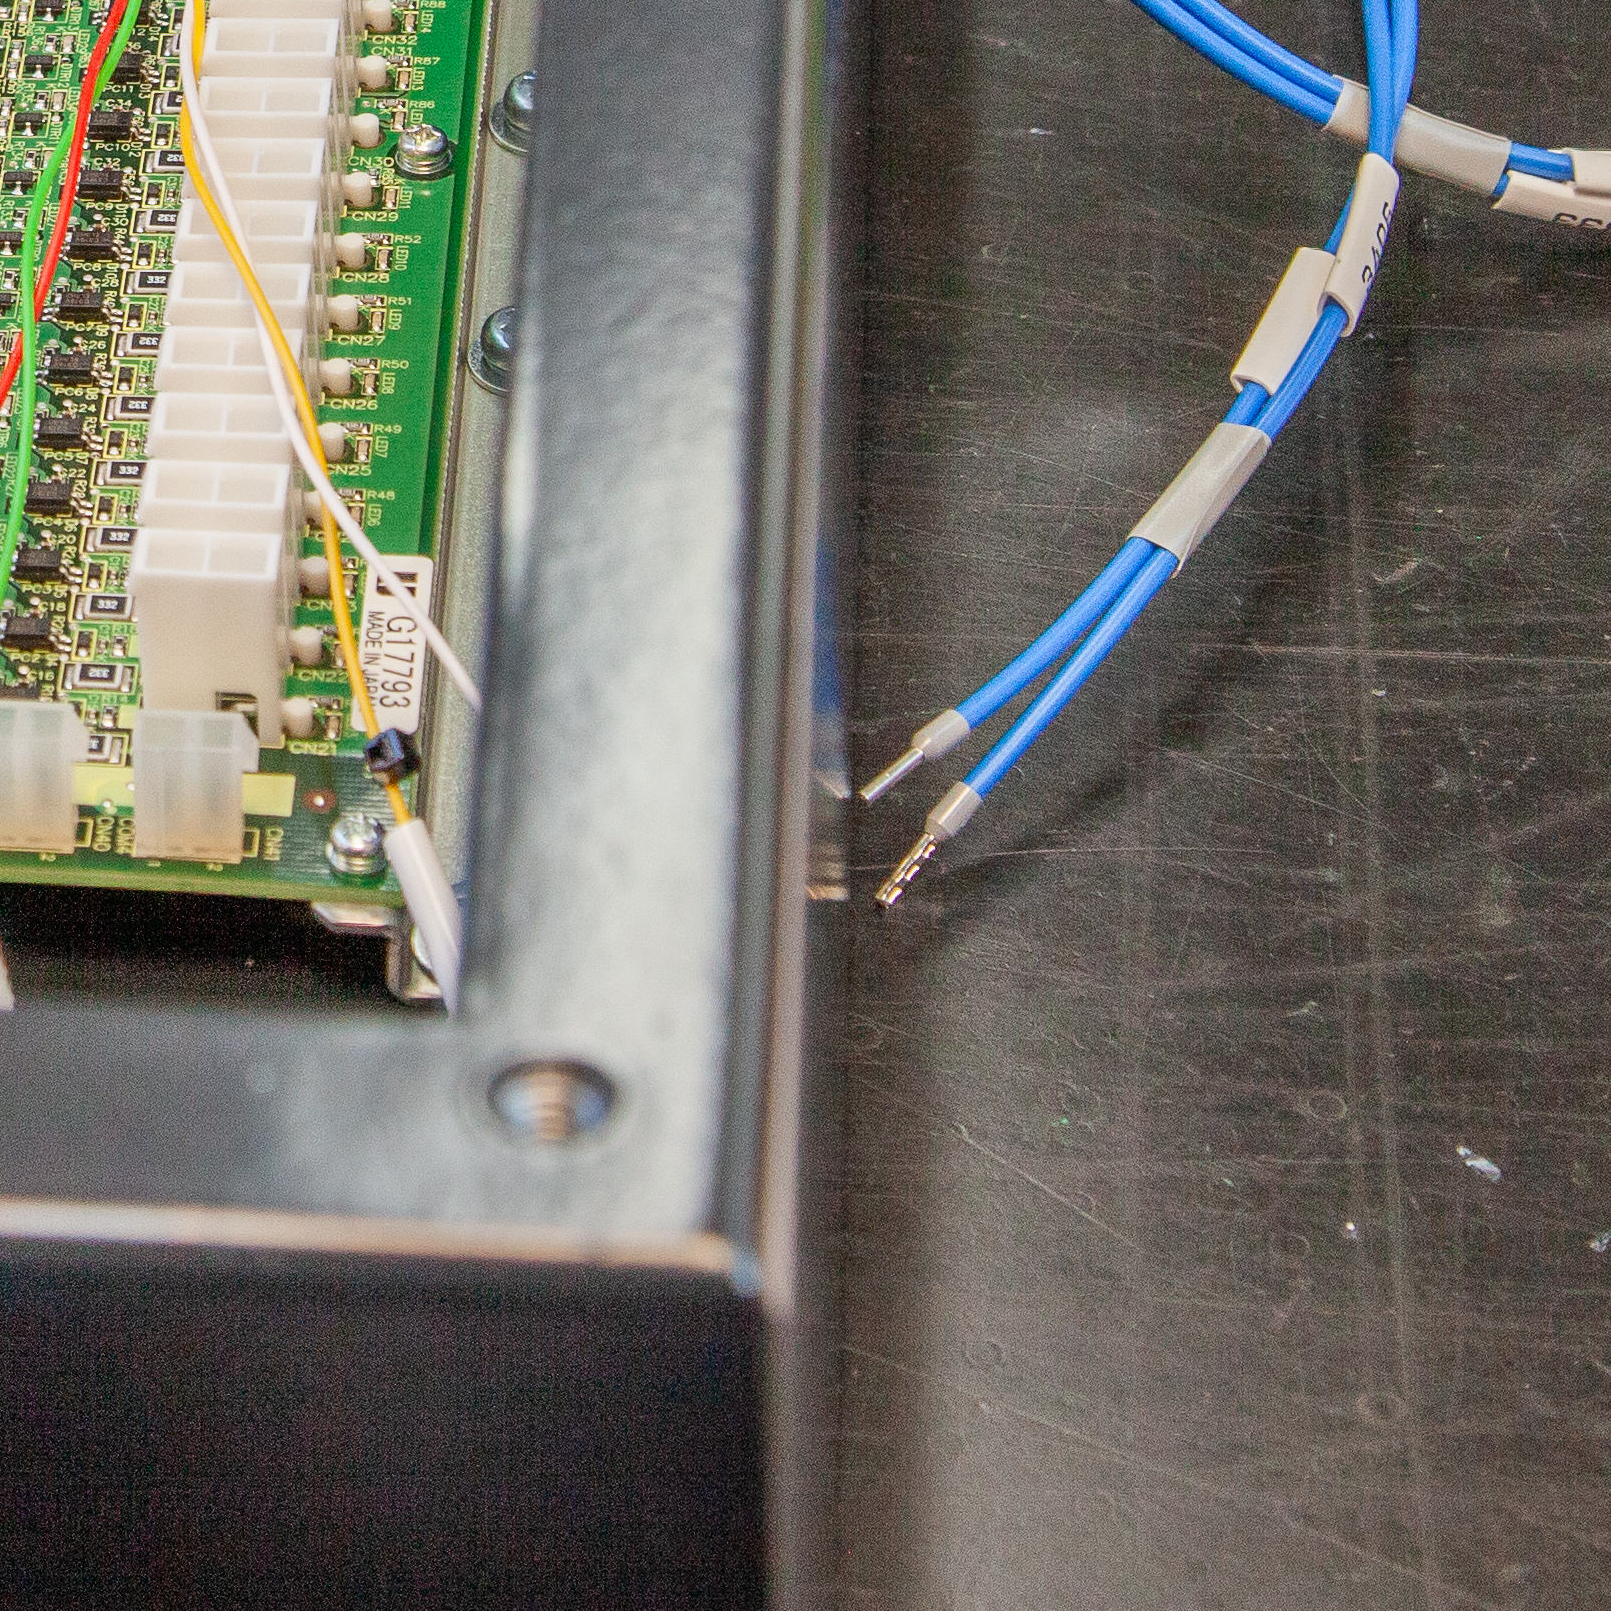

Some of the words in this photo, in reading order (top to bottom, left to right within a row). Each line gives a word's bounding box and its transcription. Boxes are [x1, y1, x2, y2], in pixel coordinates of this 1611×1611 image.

[148, 27, 160, 41] D14
[372, 35, 417, 45] CN32
[371, 47, 412, 55] CN31
[60, 64, 73, 88] DTR12
[139, 84, 151, 99] D13
[106, 99, 131, 107] C34
[50, 122, 63, 144] DTR11
[95, 143, 129, 151] PC10
[129, 142, 142, 157] D12
[94, 158, 121, 166] C32
[348, 157, 394, 167] CN30
[86, 202, 113, 210] PC9
[115, 204, 127, 217] D11
[158, 214, 177, 222] 332
[352, 211, 398, 221] CN29
[101, 218, 129, 226] C30
[394, 245, 409, 270] LED10
[73, 263, 101, 271] PC8
[105, 263, 119, 278] D10
[147, 275, 166, 284] 332
[342, 272, 390, 283] CN28
[387, 297, 412, 305] R51
[388, 309, 402, 330] LED9
[96, 324, 109, 336] D9
[139, 337, 159, 345] 332
[338, 335, 386, 346] CN27
[381, 360, 409, 368] R50
[381, 372, 395, 394] LED8
[55, 388, 83, 396] PC6
[85, 388, 99, 400] D8
[128, 401, 149, 410] 332
[330, 399, 378, 409] CN26
[374, 425, 402, 433] R49
[376, 436, 389, 458] LED7
[44, 452, 74, 460] PC5
[76, 452, 88, 464] D7
[119, 466, 139, 475] 332
[367, 491, 395, 500] R48
[65, 519, 78, 532] D6
[109, 532, 130, 541] 332
[98, 599, 118, 609] 332
[365, 611, 385, 648] MADE
[364, 653, 383, 665] IN
[379, 616, 418, 708] G17793
[89, 668, 109, 678] 332
[92, 817, 114, 852] CN40
